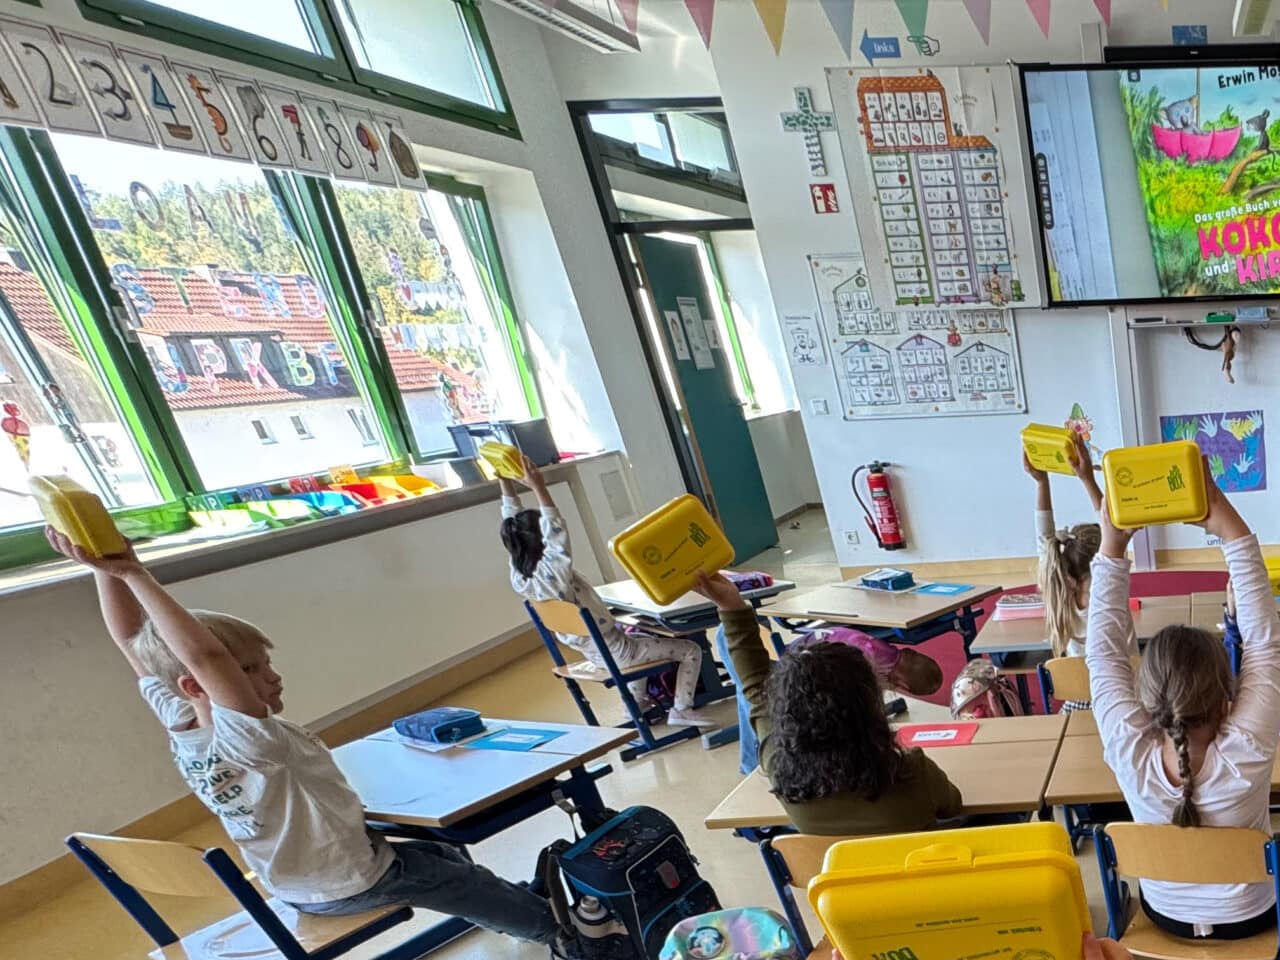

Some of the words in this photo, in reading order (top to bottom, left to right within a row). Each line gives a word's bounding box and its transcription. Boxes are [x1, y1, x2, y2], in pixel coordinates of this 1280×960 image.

[873, 41, 895, 53] links
[21, 42, 74, 106] 2
[1217, 67, 1256, 89] Erwin
[81, 57, 133, 121] 3
[321, 112, 353, 169] 8
[1194, 212, 1213, 224] Das
[1215, 205, 1243, 223] große
[1245, 200, 1269, 214] Buch
[1205, 261, 1229, 278] und
